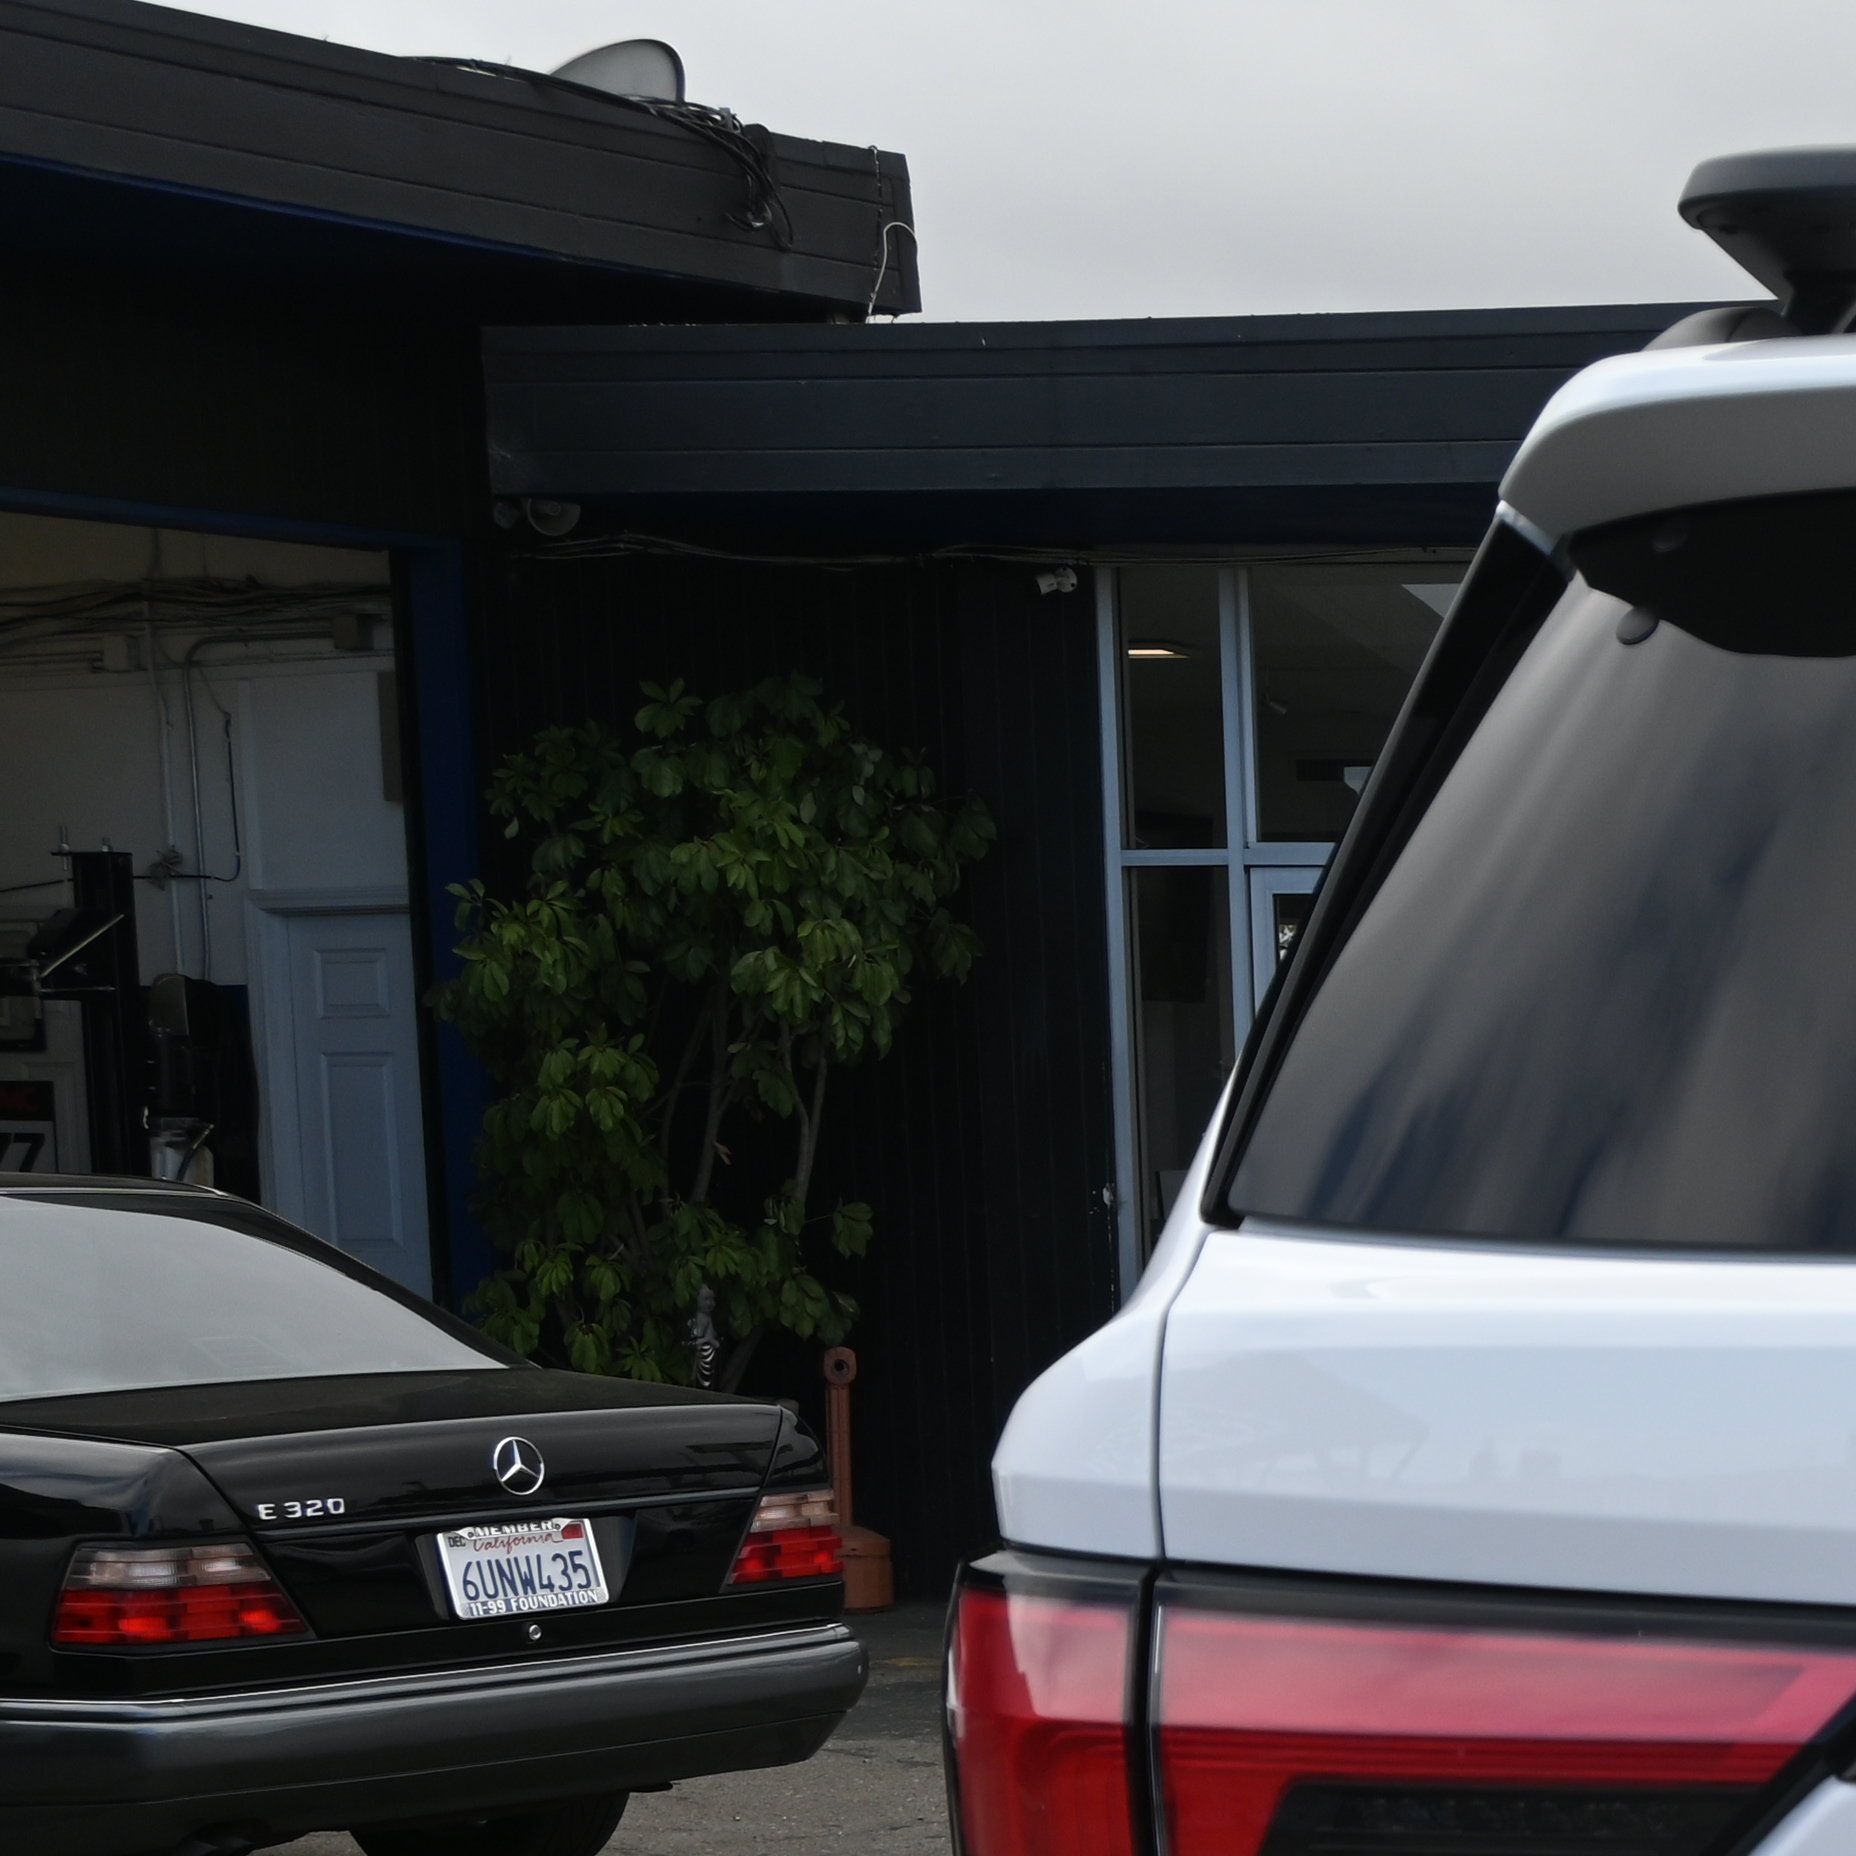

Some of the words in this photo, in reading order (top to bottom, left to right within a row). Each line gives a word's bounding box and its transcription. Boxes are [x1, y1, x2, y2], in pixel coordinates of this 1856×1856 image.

[257, 1503, 277, 1520] E
[283, 1498, 345, 1518] 320
[473, 1520, 554, 1537] MEMBER
[448, 1535, 466, 1548] DEC
[473, 1532, 562, 1554] California
[462, 1550, 592, 1601] 6UNW435
[469, 1600, 507, 1617] 11-99
[511, 1590, 599, 1612] FOUNDATION
